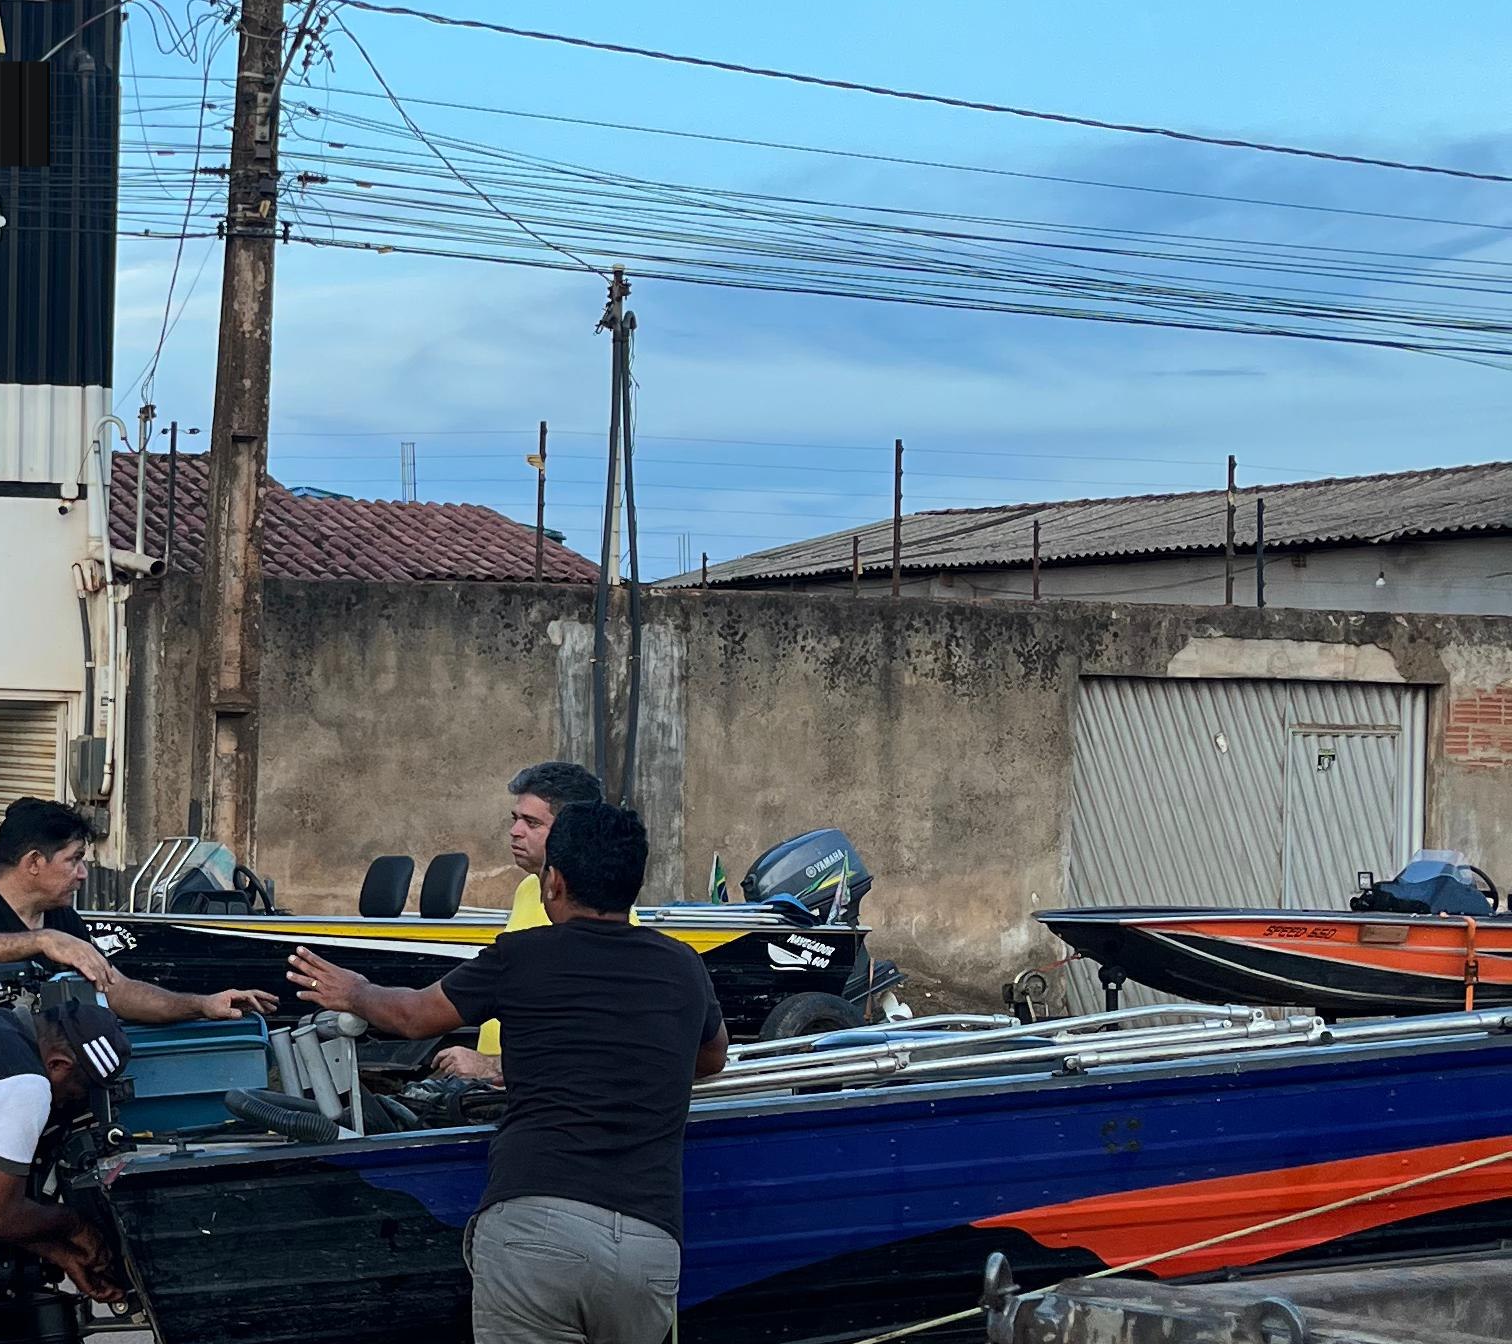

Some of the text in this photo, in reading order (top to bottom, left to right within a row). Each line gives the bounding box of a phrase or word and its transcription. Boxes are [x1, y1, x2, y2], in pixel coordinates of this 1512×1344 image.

[814, 849, 845, 873] YAMAHA
[96, 922, 112, 931] DA
[114, 925, 138, 950] PESCA
[1263, 925, 1308, 938] SPEED
